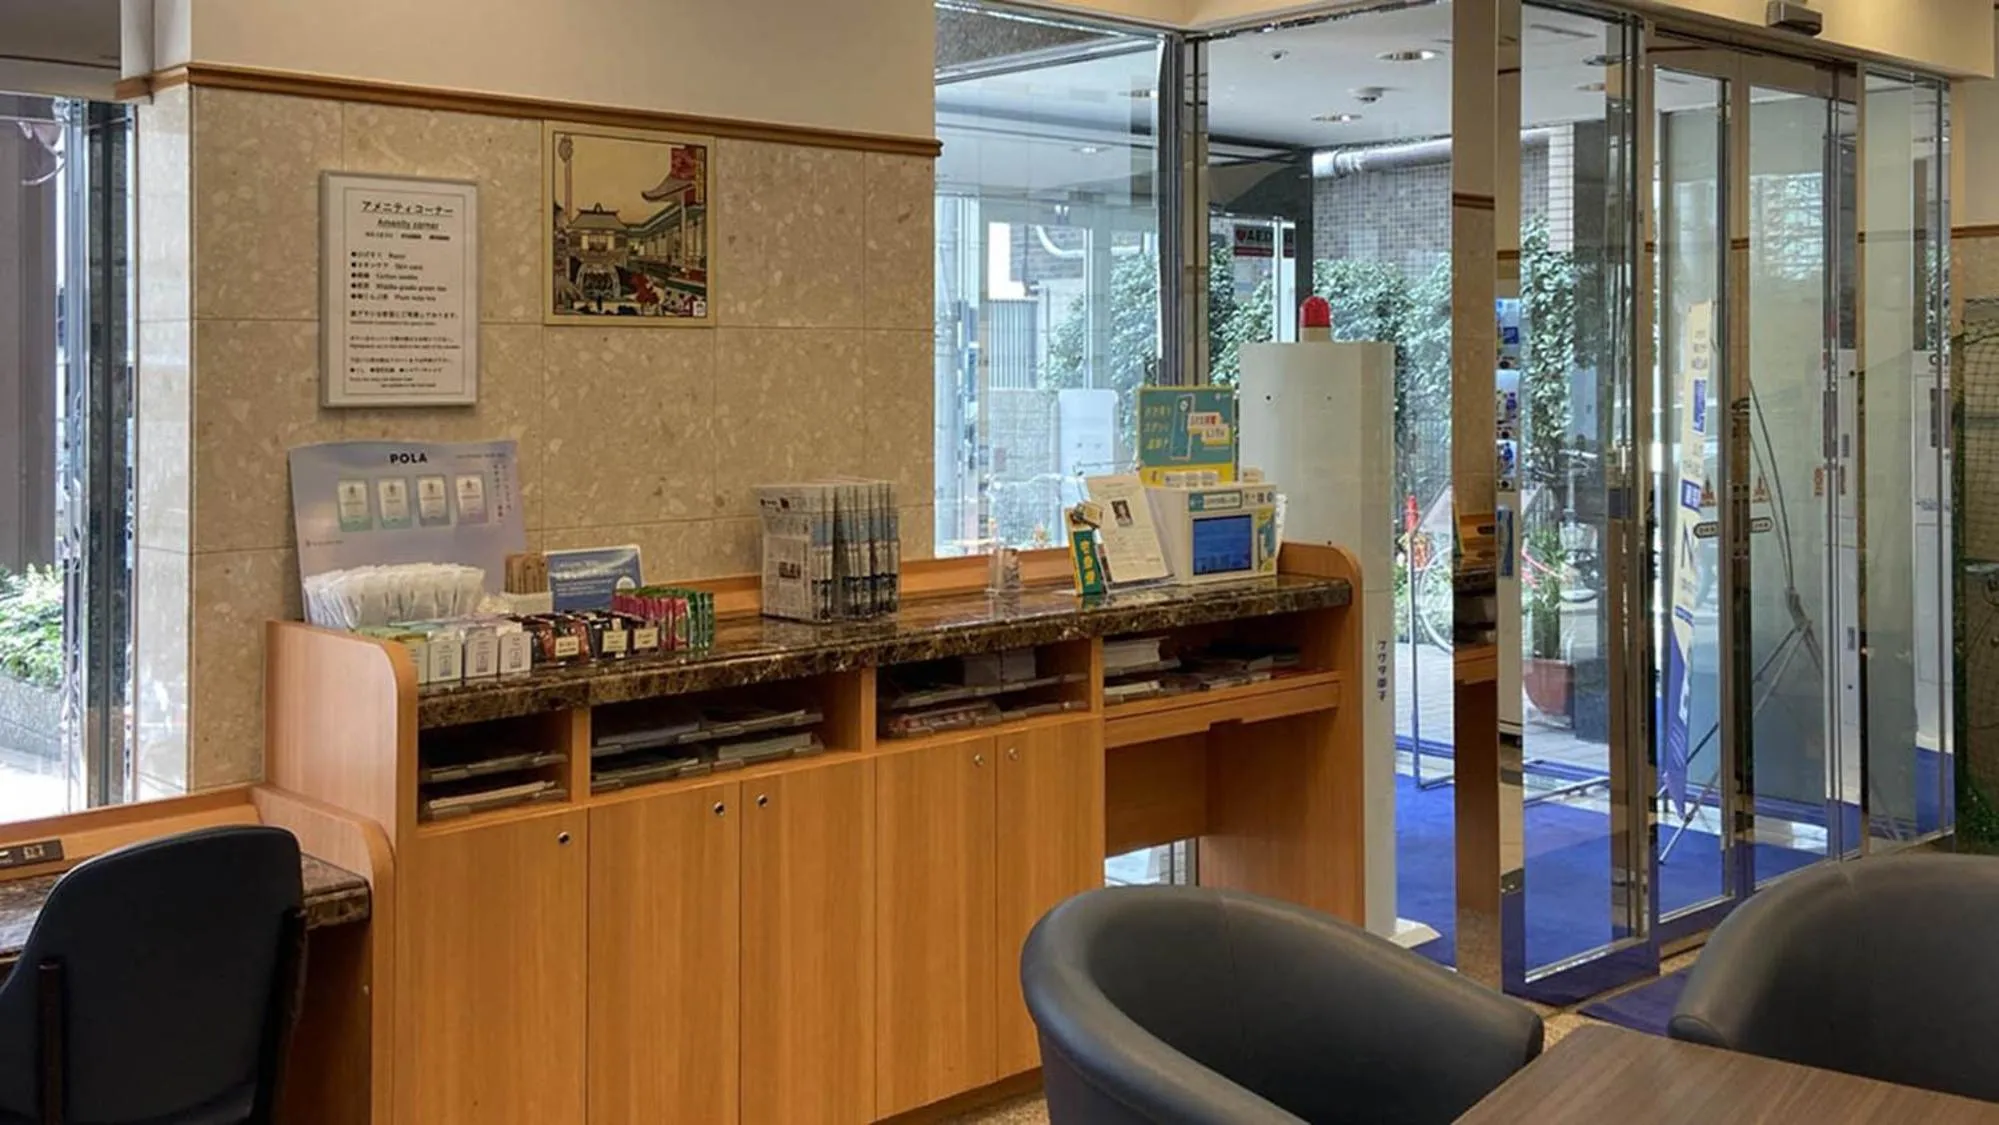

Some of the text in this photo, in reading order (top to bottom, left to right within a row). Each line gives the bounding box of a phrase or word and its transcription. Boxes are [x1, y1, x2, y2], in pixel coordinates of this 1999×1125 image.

[362, 200, 453, 215] アメニティコーナー
[378, 219, 439, 230] Amenity corner
[389, 452, 428, 464] POLA
